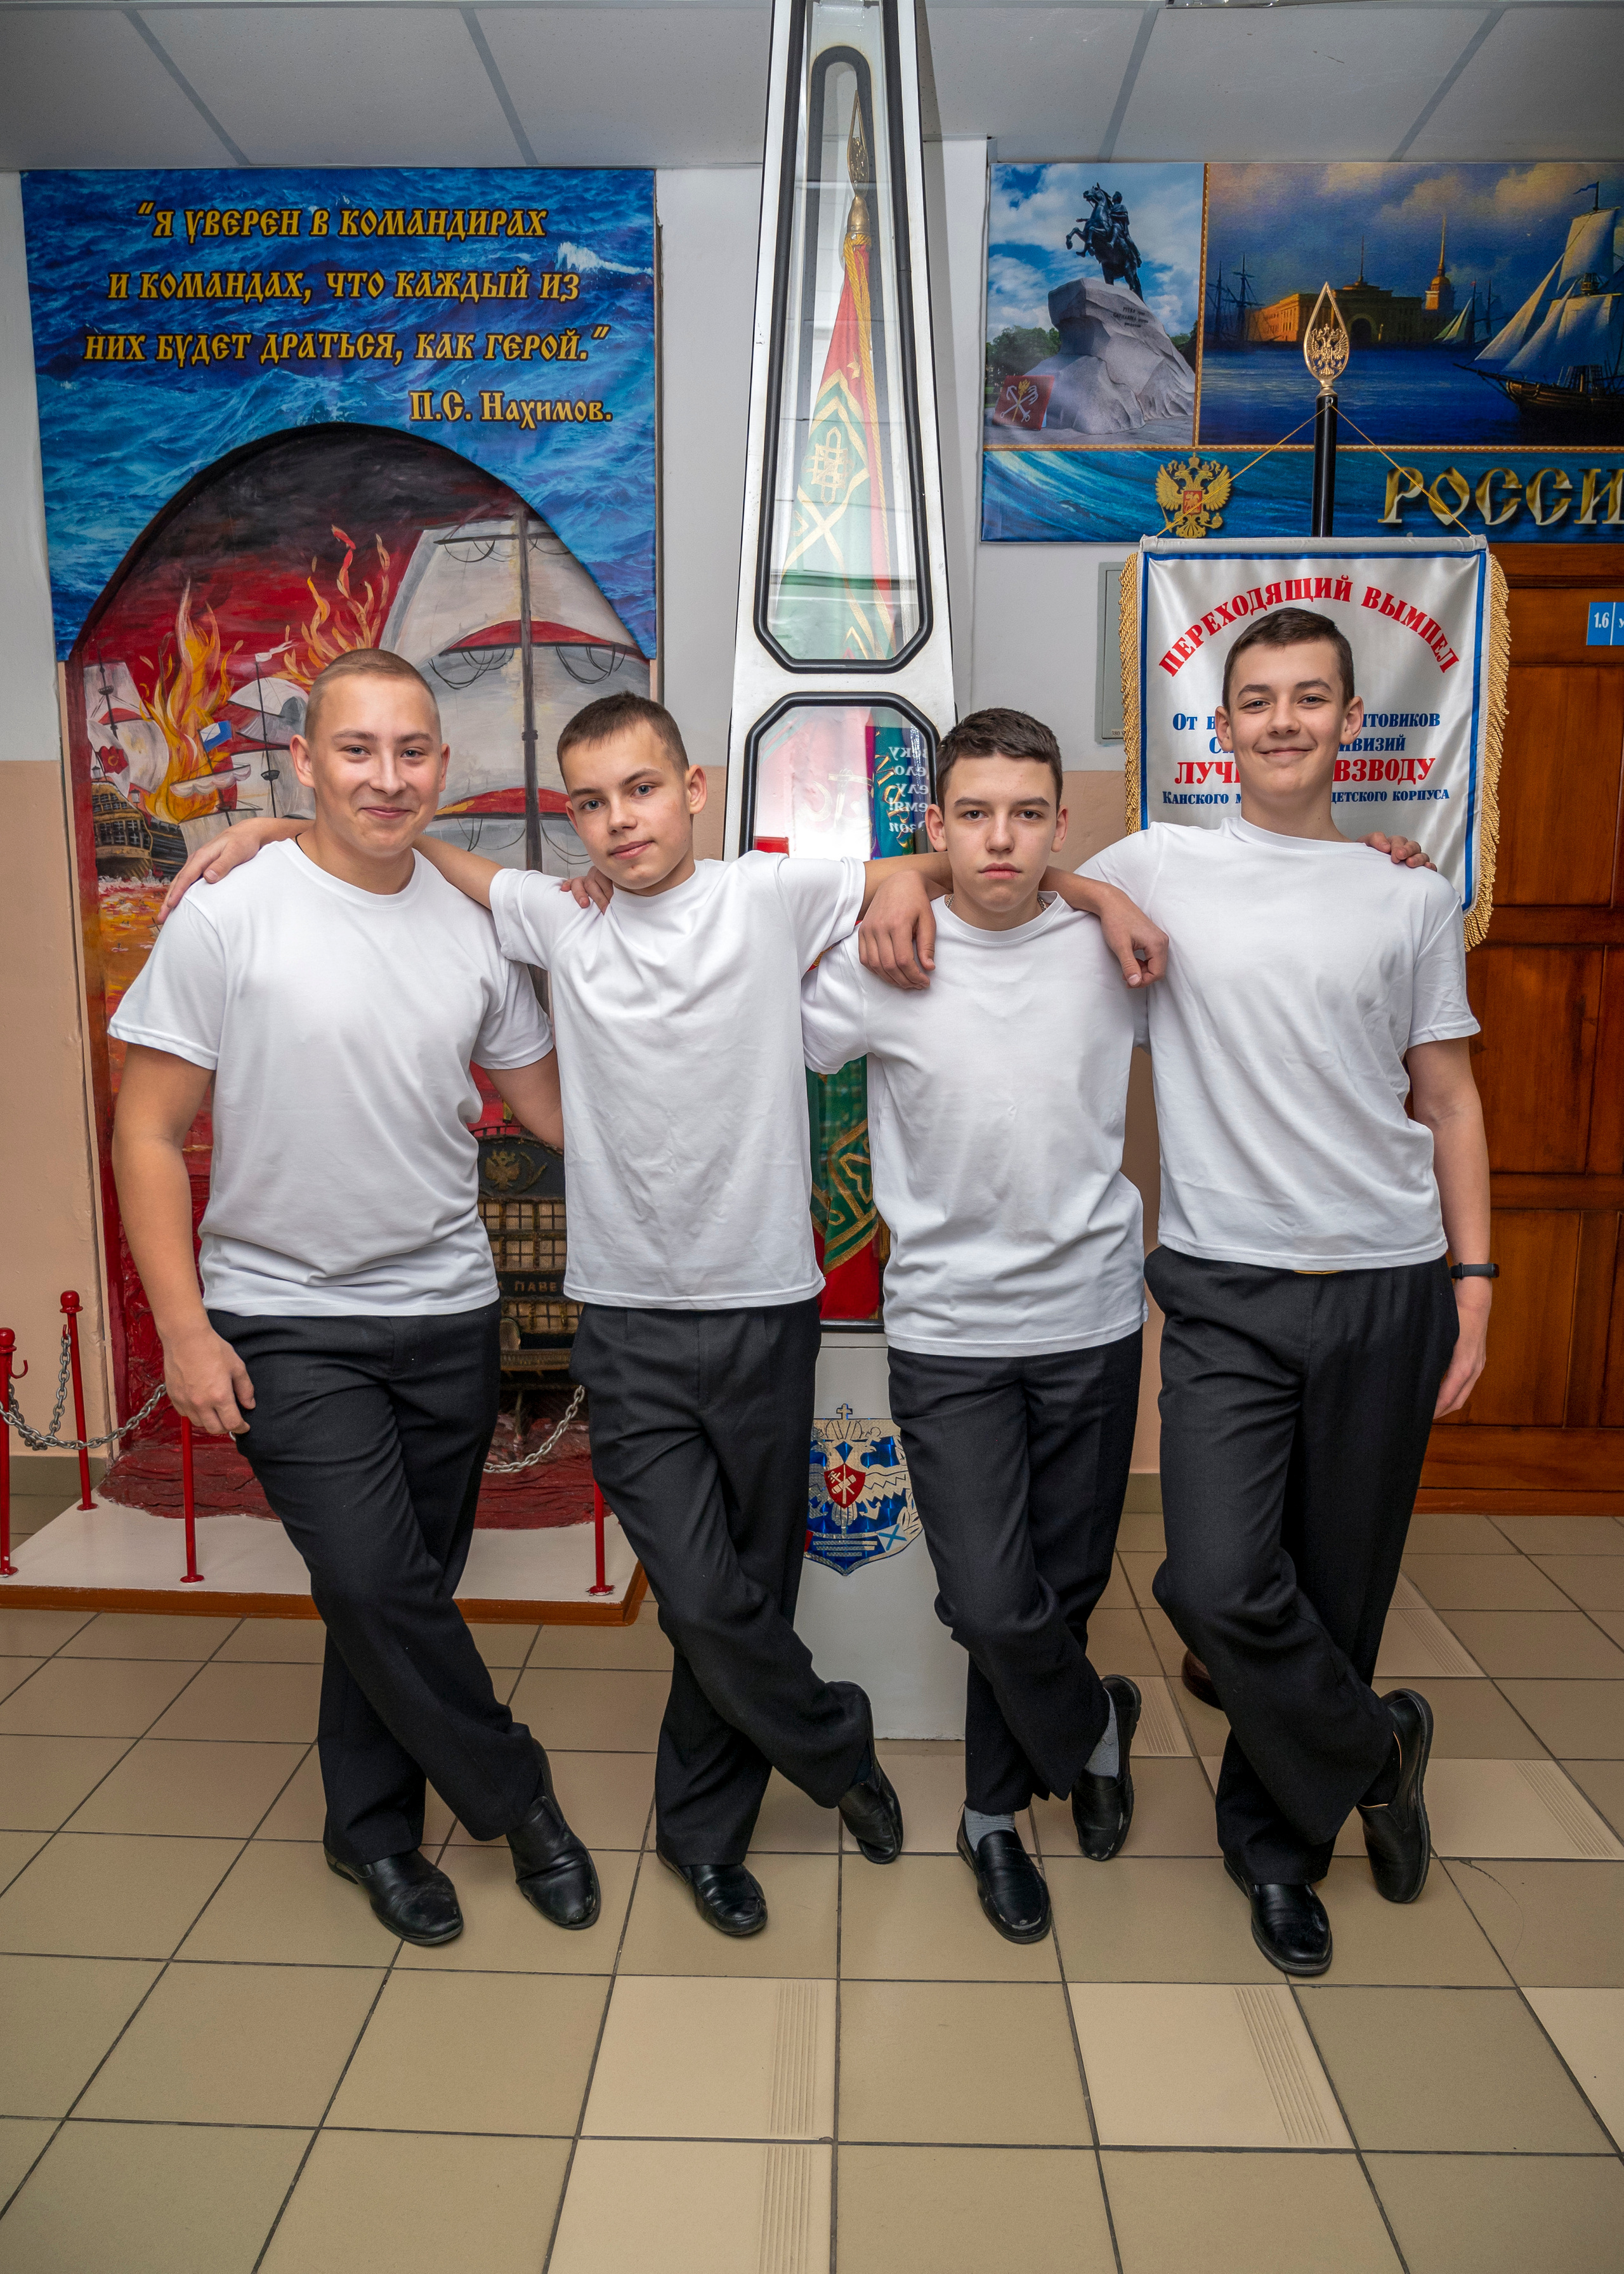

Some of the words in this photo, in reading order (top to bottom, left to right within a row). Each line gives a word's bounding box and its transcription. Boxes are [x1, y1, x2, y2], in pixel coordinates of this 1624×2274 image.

[185, 209, 301, 244] УВЕРЕН
[310, 209, 329, 235] В
[339, 209, 547, 240] КОМАНДИРАХ
[107, 273, 129, 298] И
[139, 272, 311, 305] КОМАНДАХ,
[325, 272, 384, 298] ЧТО
[394, 266, 531, 303] КАЖДЫЙ
[539, 273, 580, 303] ИЗ
[84, 334, 145, 360] НИХ
[156, 334, 252, 367] БУДЕТ
[259, 333, 403, 366] ДРАТЬСЯ,
[414, 332, 475, 360] КАК
[409, 391, 471, 421] П.С.
[480, 391, 613, 430] Нахимов.
[1159, 575, 1353, 677] ПЕРЕХОДЯЩИЙ
[1361, 586, 1459, 673] ВЫМПЕЛ
[1594, 612, 1610, 629] 1.6
[1174, 761, 1241, 784] ЛУЧ
[1333, 758, 1436, 785] ВЗВОДУ
[514, 1280, 564, 1292] ПАВЕ
